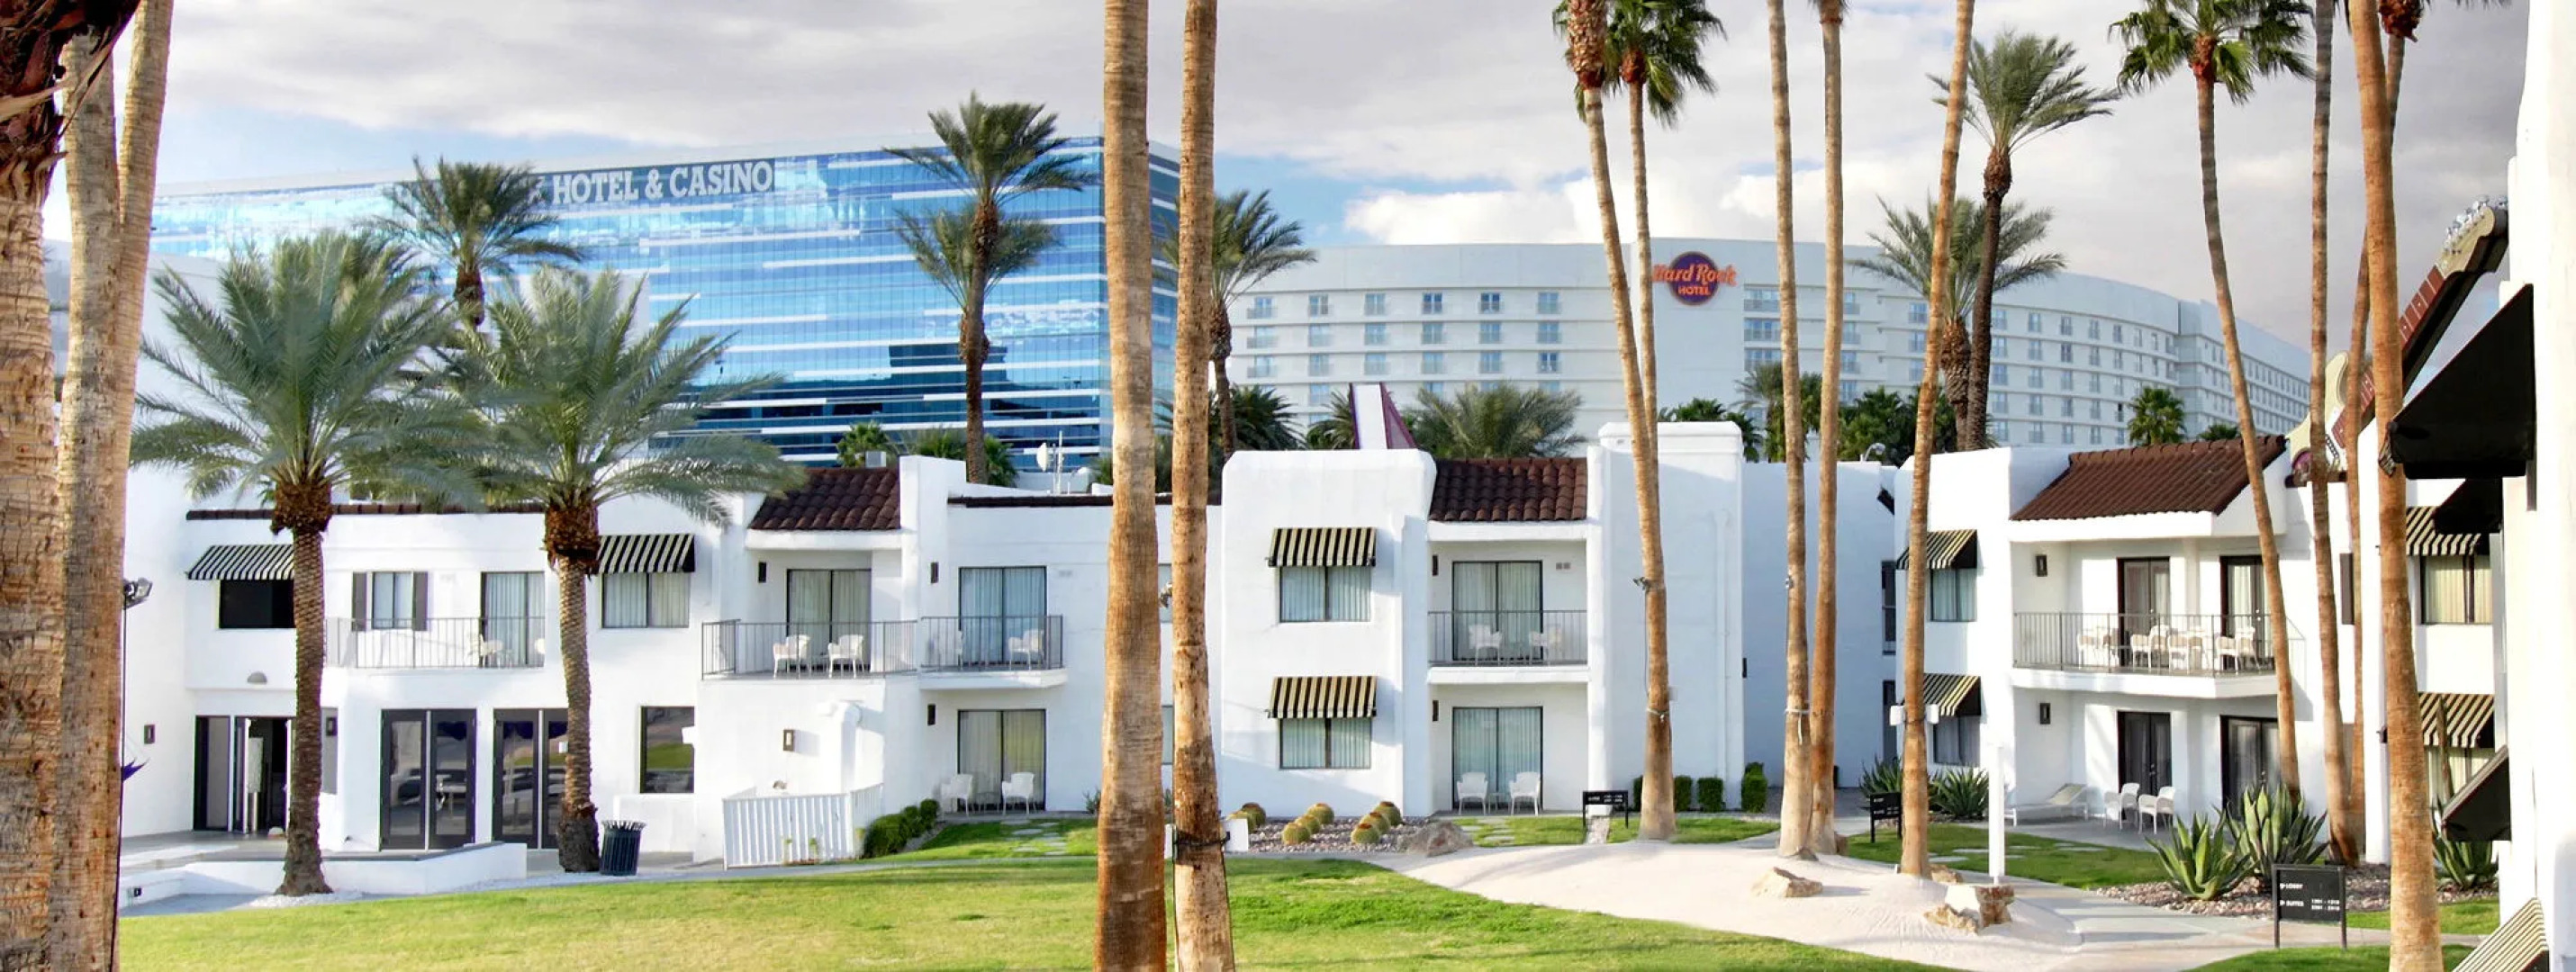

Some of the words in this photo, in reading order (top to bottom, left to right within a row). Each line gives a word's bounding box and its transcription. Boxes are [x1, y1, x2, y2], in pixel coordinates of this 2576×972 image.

[552, 170, 639, 205] HOTEL
[645, 168, 664, 200] &
[669, 161, 773, 197] CASINO
[1651, 263, 1695, 282] Hard
[1696, 263, 1738, 286] Rock
[1678, 285, 1710, 295] HOTEL
